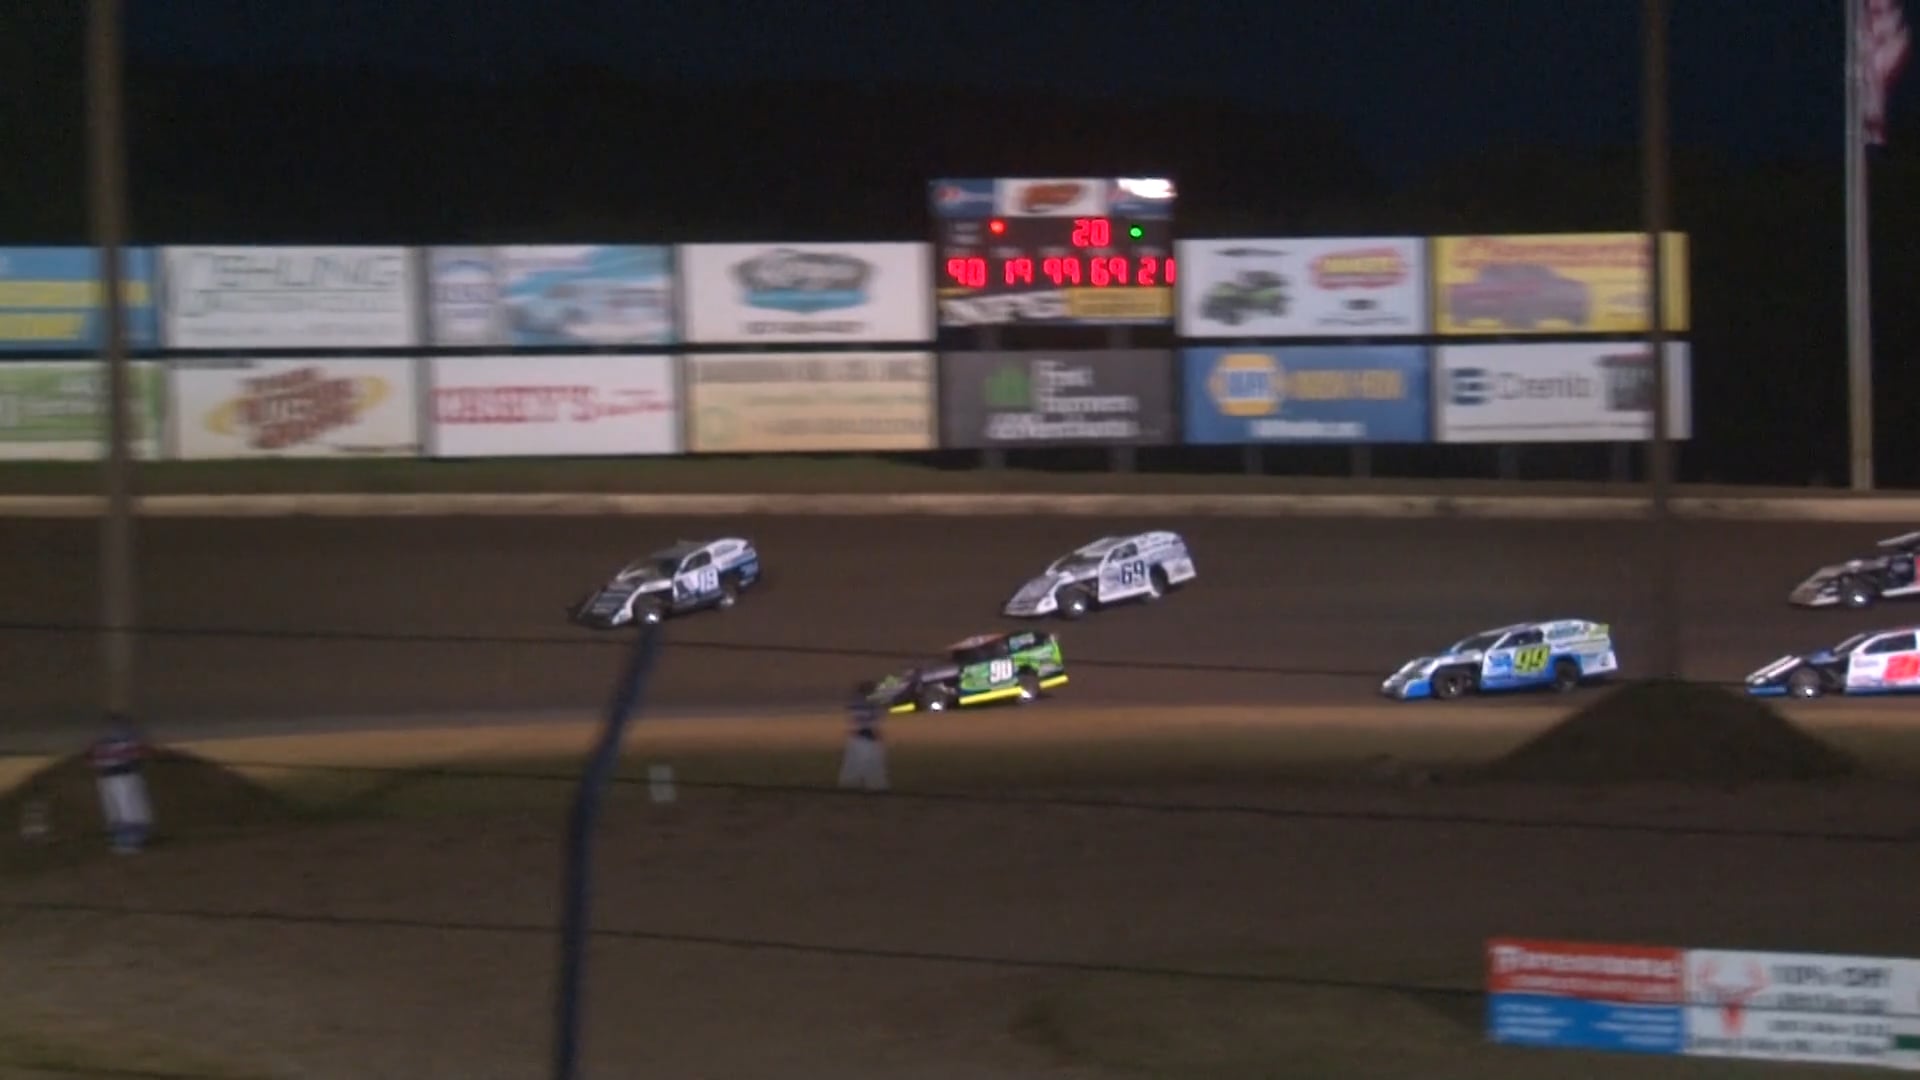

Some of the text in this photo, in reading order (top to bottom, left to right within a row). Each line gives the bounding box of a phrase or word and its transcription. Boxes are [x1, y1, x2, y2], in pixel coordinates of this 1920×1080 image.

[1072, 218, 1110, 247] 20
[947, 256, 1176, 287] 90 19 99 69 21
[1120, 560, 1145, 585] 69
[989, 658, 1013, 683] 90
[1514, 646, 1550, 674] 99
